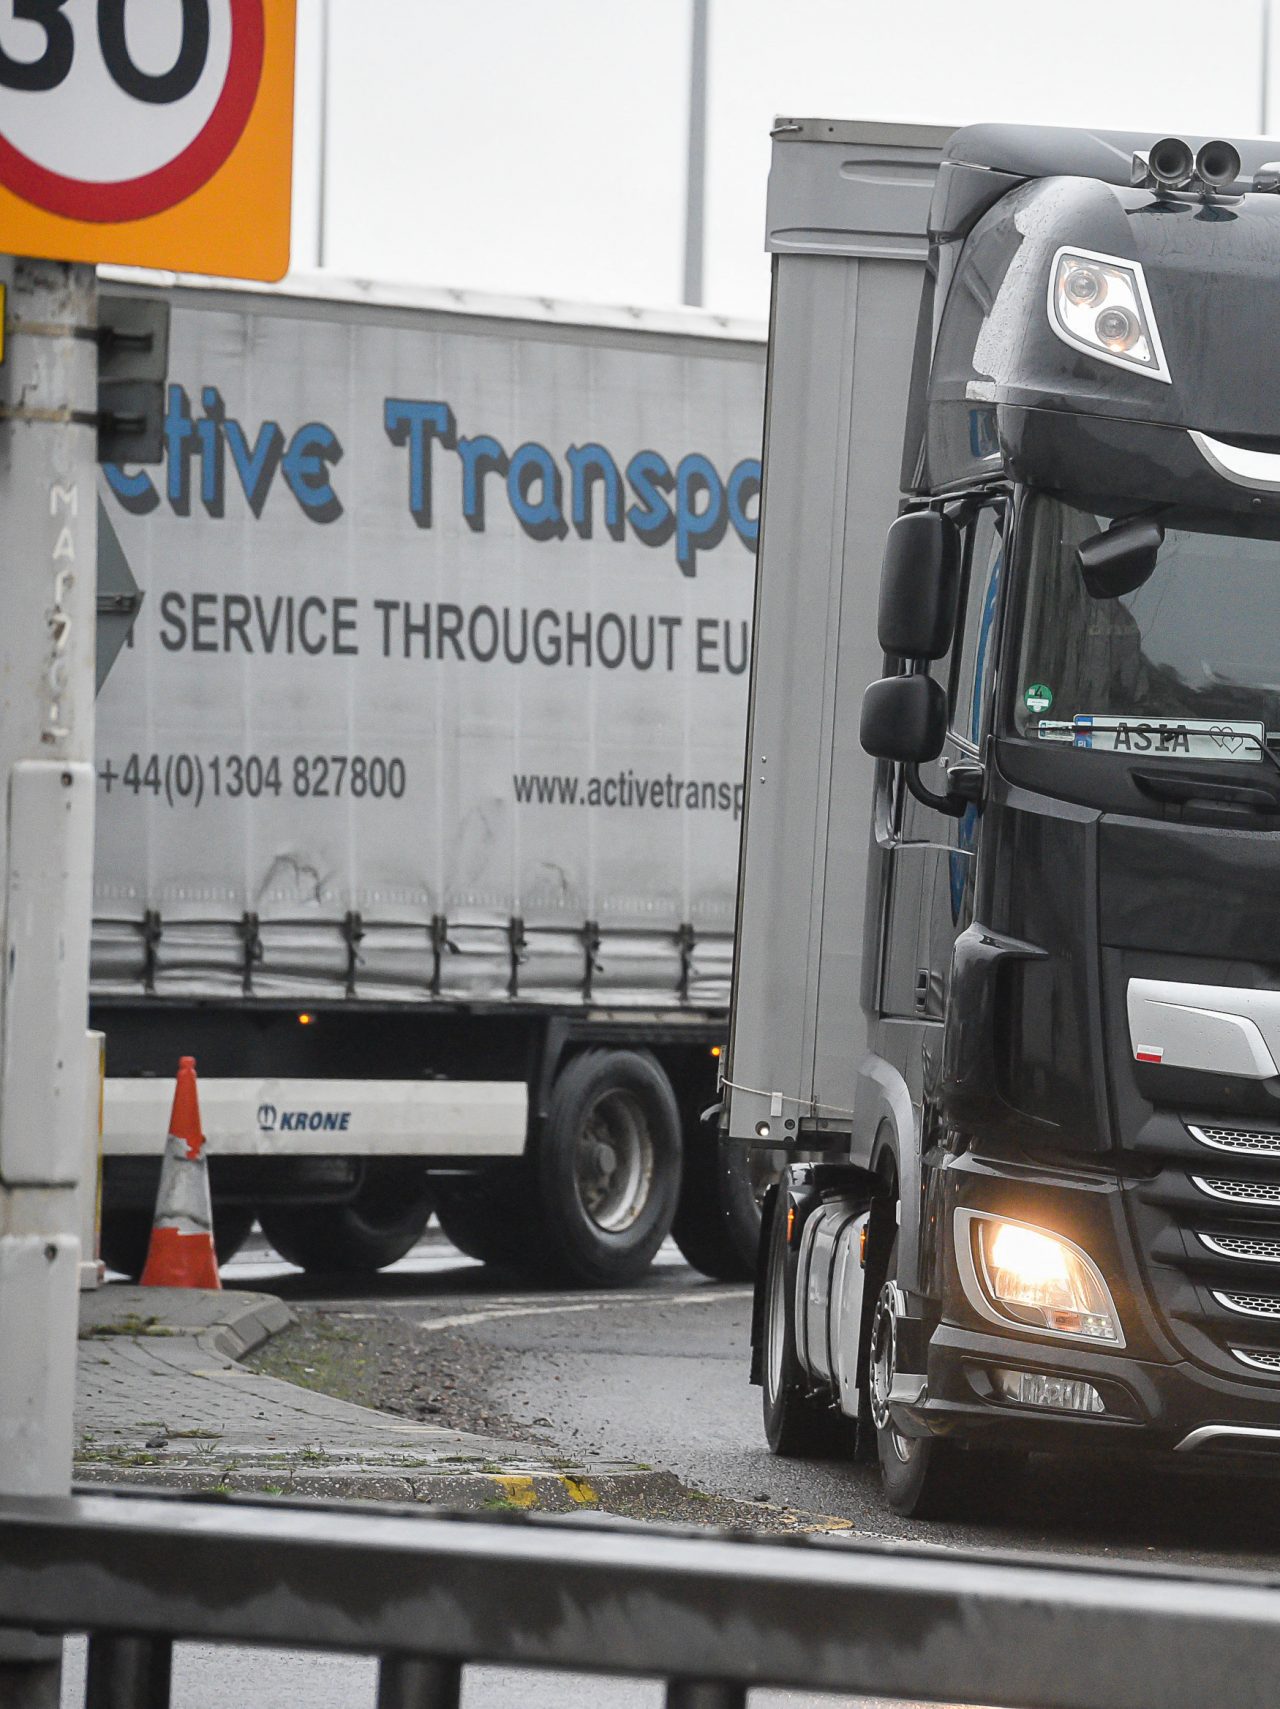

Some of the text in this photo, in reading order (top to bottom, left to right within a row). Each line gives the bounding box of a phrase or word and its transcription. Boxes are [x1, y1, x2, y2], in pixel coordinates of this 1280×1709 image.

[159, 591, 359, 656] SERVICE
[373, 599, 682, 672] THROUGHOUT
[696, 617, 748, 676] EU
[99, 753, 407, 808] +44(0)1304 827800
[280, 1111, 352, 1131] KRONE
